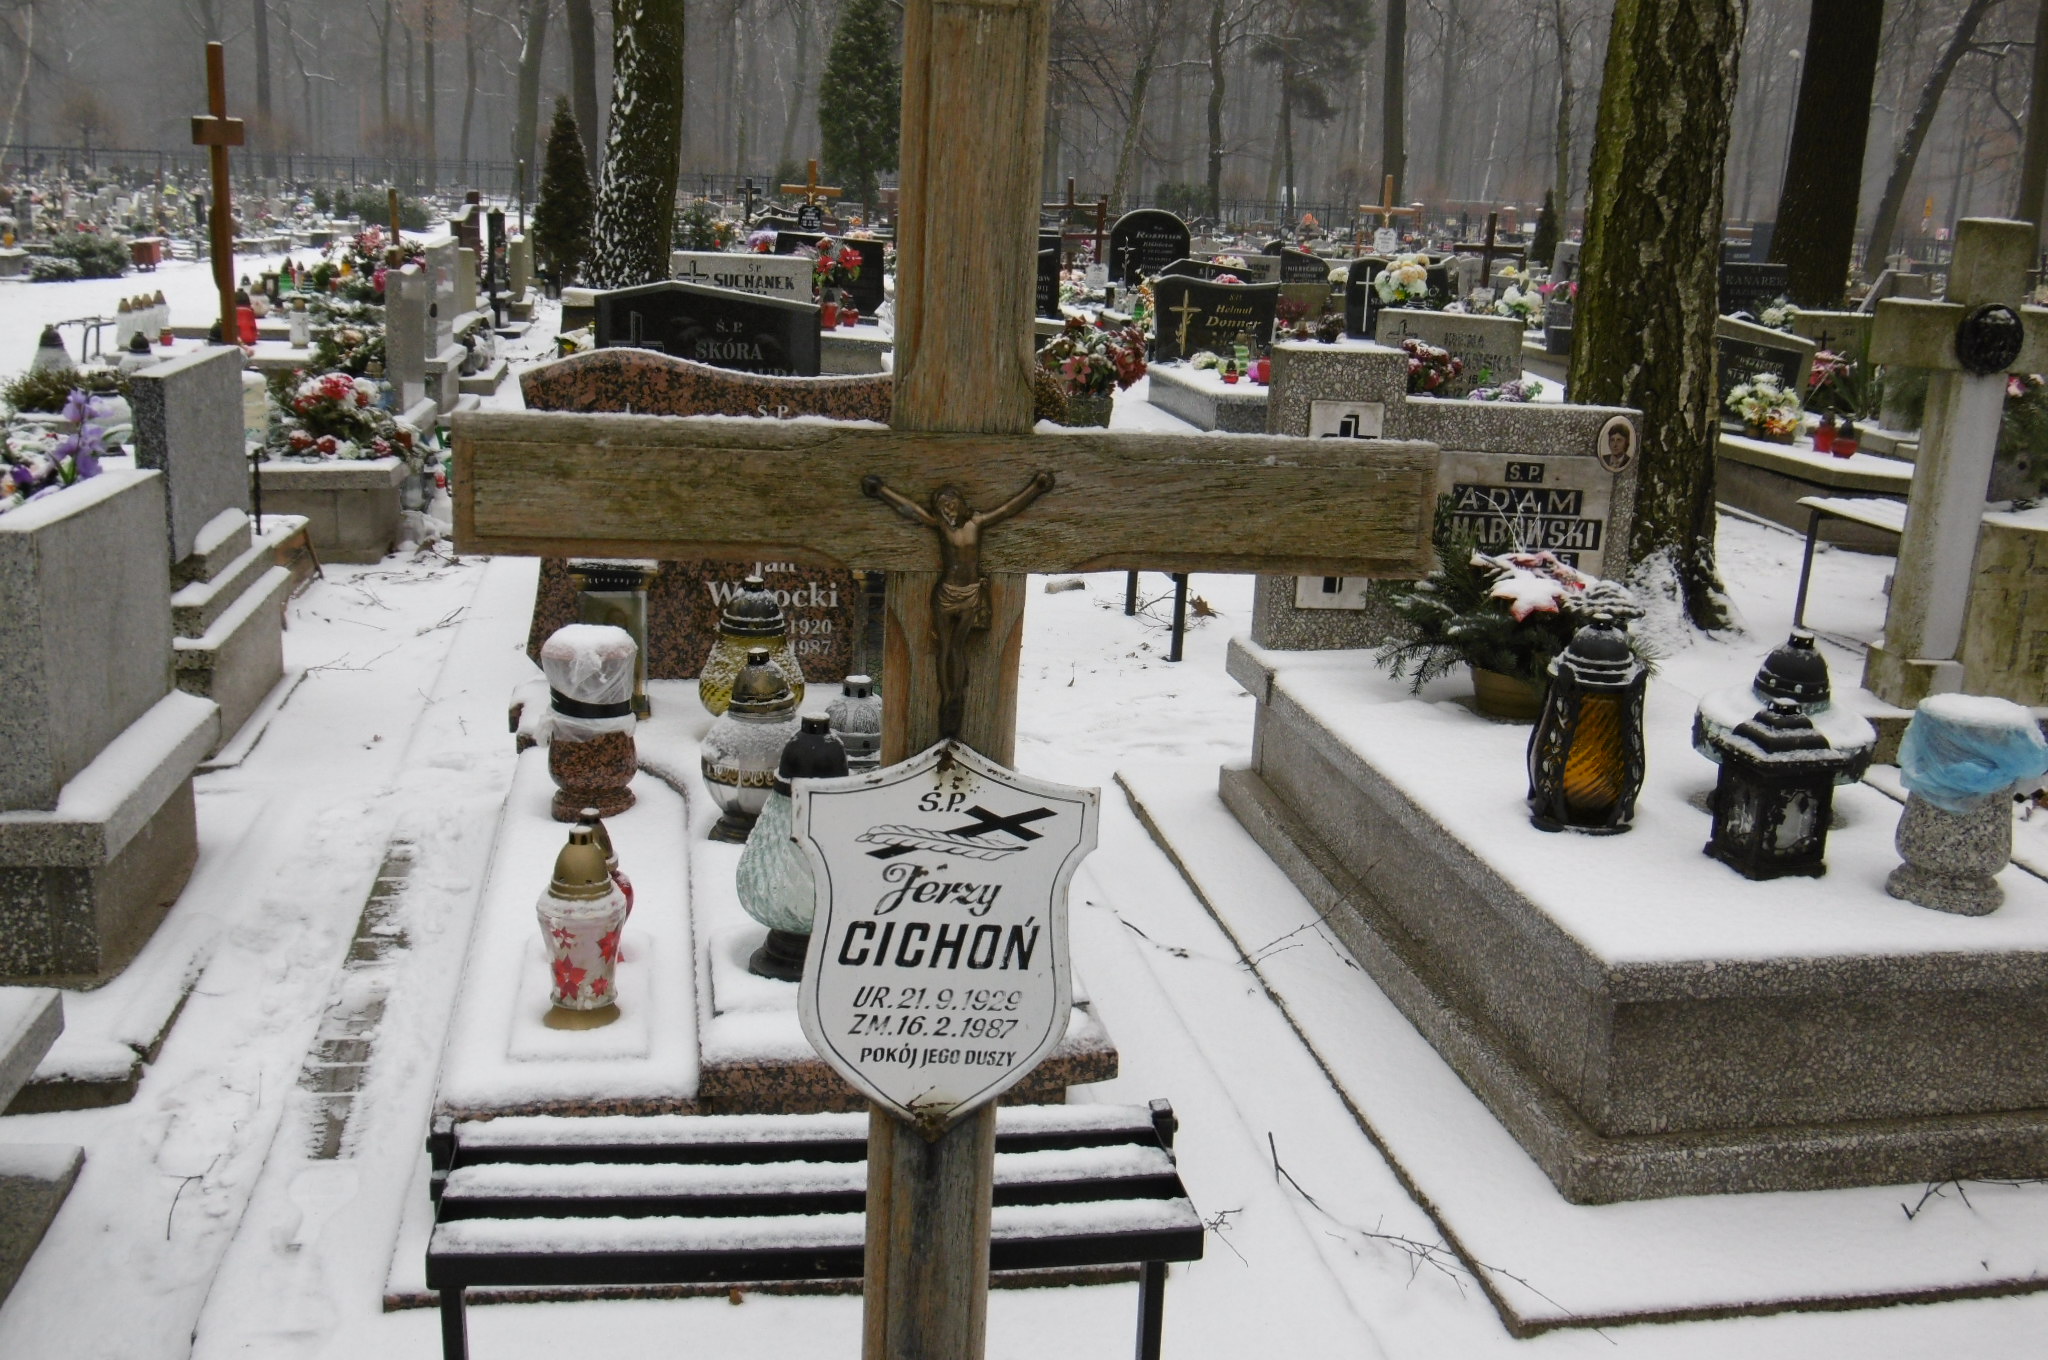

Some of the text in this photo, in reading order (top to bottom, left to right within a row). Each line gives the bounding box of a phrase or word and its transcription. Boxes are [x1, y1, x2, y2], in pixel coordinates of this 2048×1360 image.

[713, 272, 795, 290] SUCHANEK
[1216, 304, 1253, 315] Helmut
[695, 338, 764, 361] SKÓRA
[1457, 486, 1577, 514] ADAM
[705, 581, 839, 608] Wocki
[874, 861, 1003, 917] Jerzy
[837, 915, 1041, 971] CICHOŃ
[859, 1042, 1017, 1070] POKÓJ JEGO DUSZY
